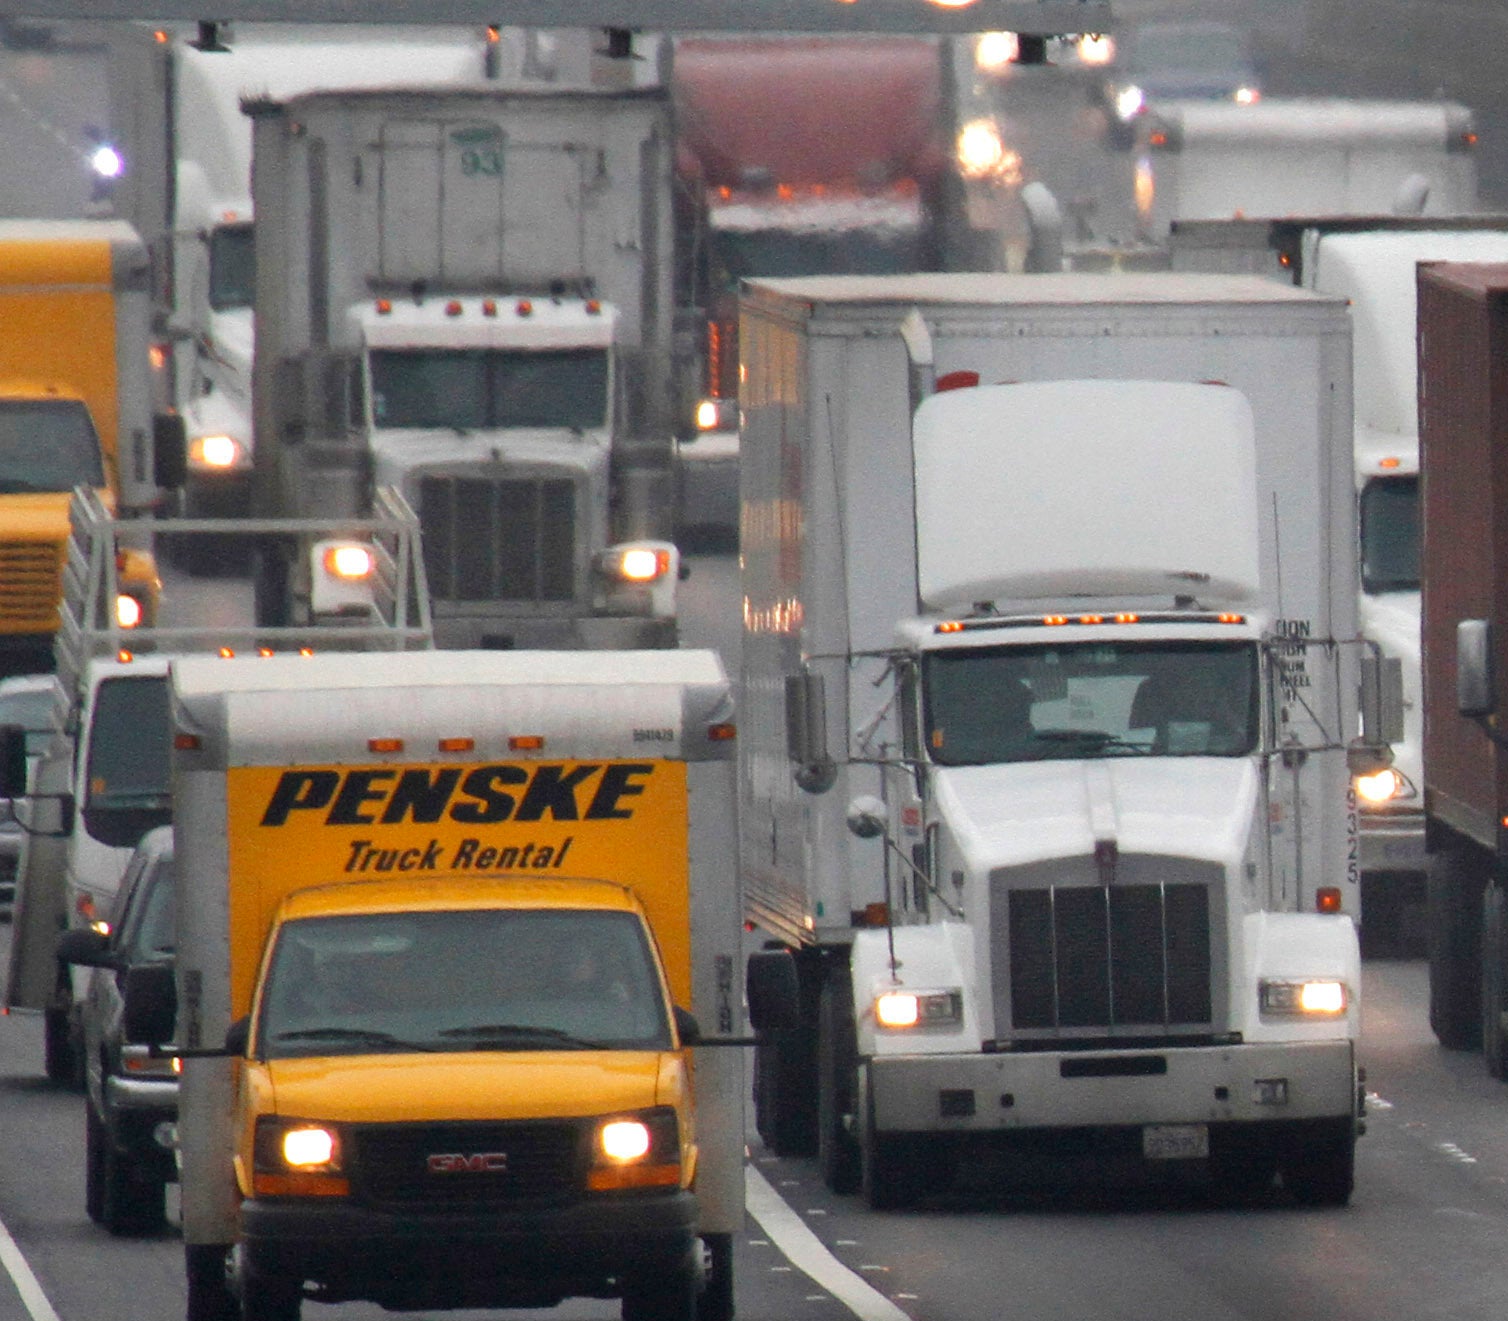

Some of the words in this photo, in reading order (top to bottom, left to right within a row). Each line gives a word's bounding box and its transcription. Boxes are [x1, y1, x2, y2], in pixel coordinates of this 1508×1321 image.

[259, 763, 655, 827] PENSKE
[345, 838, 445, 873] Truck
[450, 836, 574, 872] Rental
[427, 1152, 507, 1173] GMC
